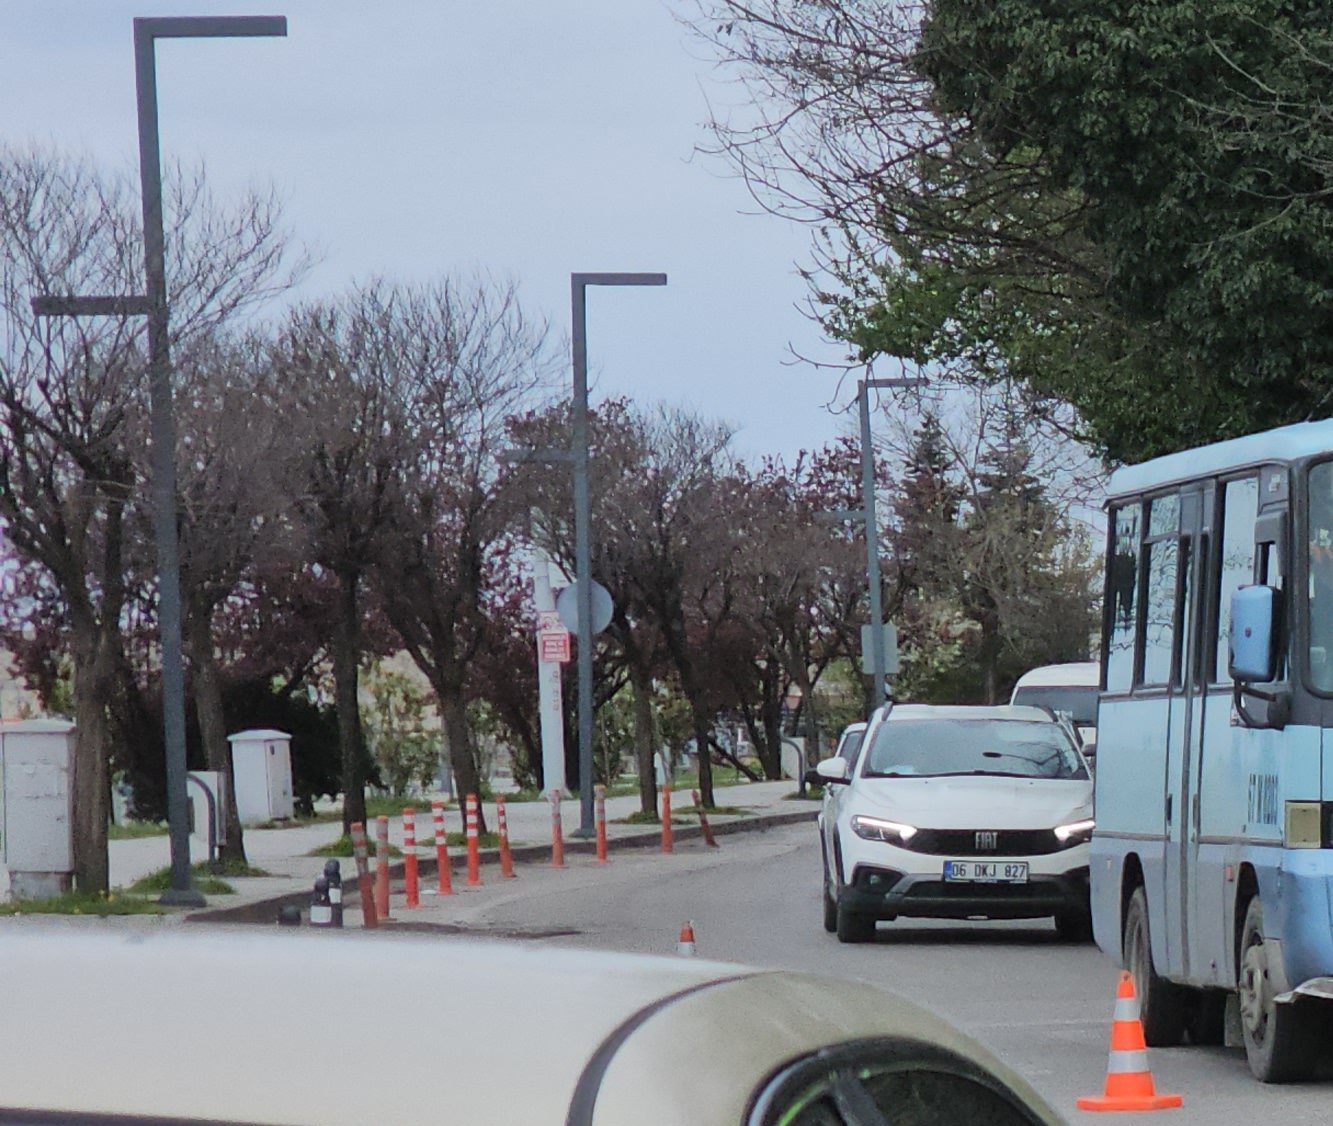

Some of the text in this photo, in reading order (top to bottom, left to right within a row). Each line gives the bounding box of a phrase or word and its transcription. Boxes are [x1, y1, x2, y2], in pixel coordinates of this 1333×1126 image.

[975, 832, 998, 849] FIAT
[952, 864, 1027, 878] 06 DKJ 827
